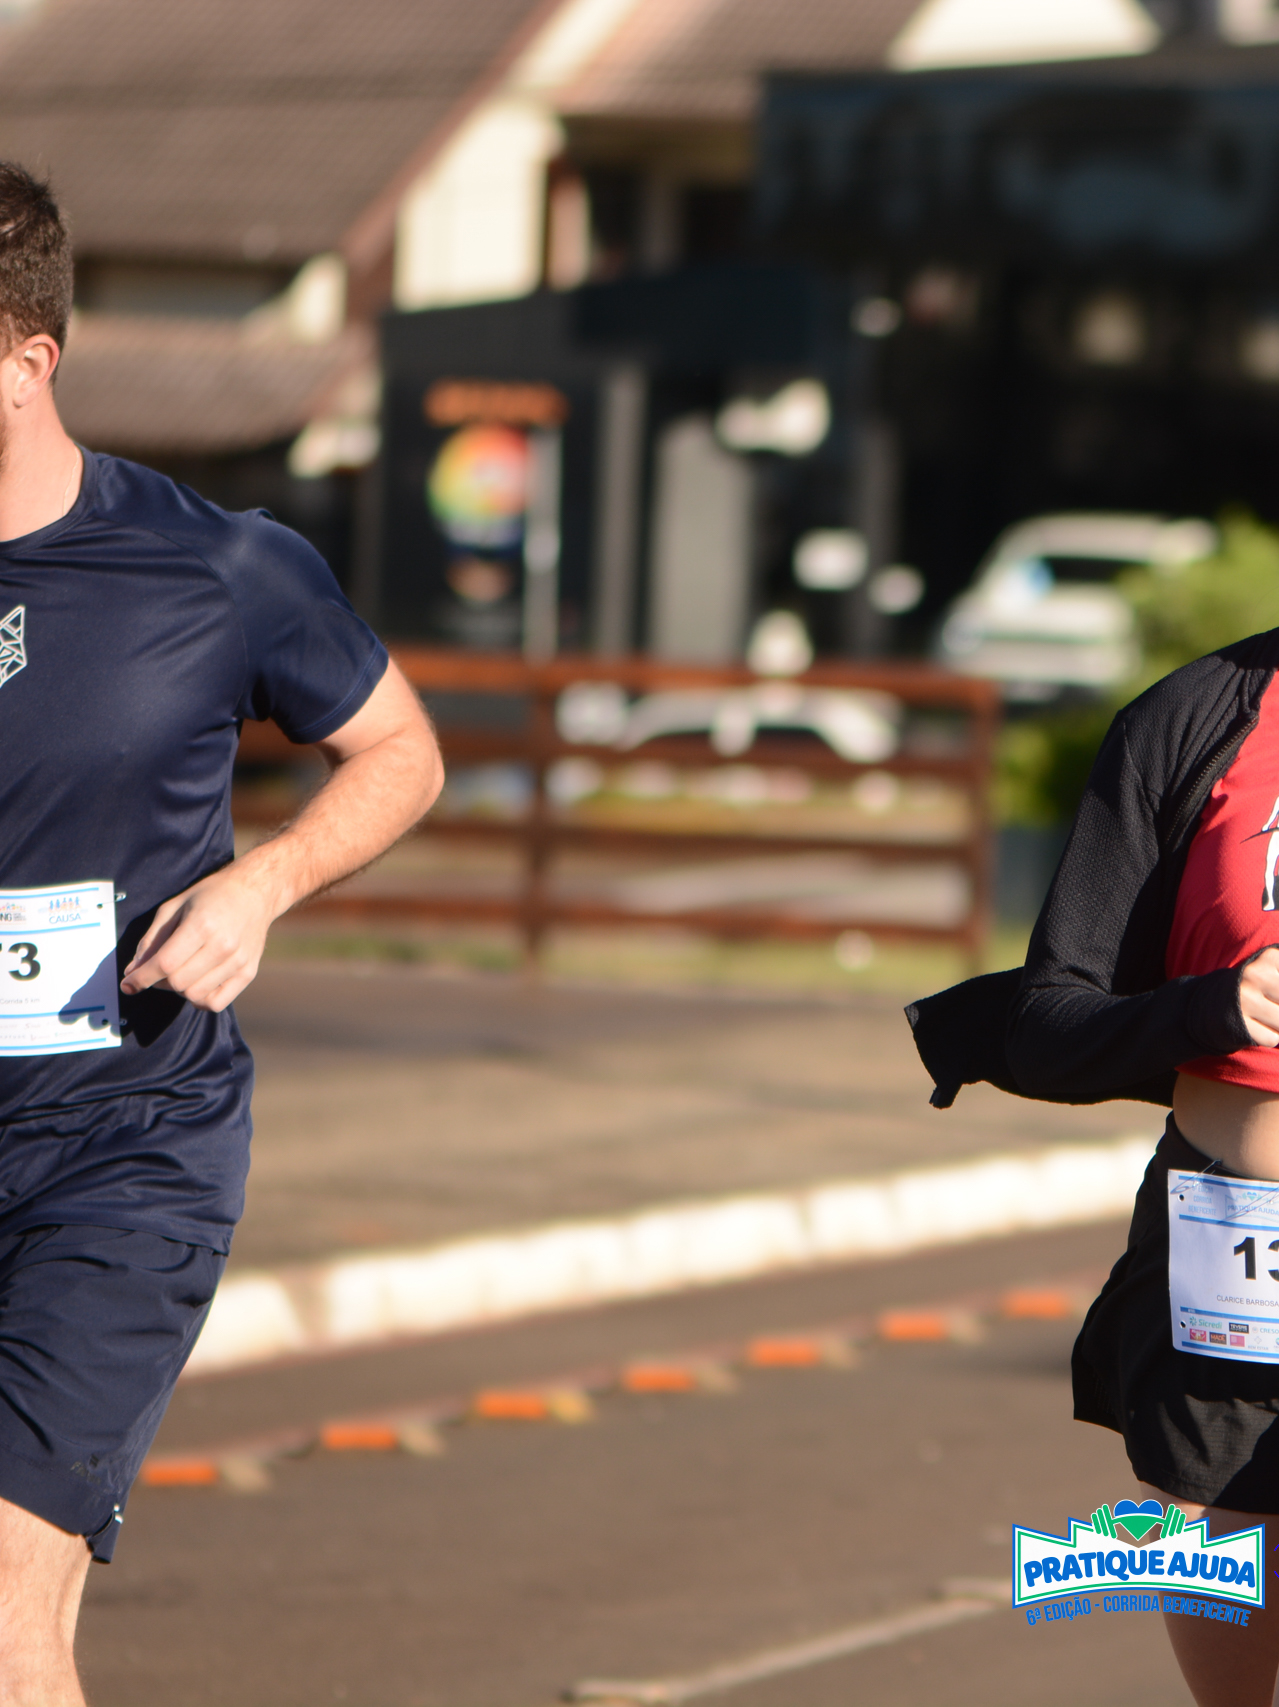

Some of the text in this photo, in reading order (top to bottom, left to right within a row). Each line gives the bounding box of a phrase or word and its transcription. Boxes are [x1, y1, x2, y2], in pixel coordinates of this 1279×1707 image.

[49, 912, 82, 924] CAUSA
[0, 942, 41, 982] 3
[1259, 1206, 1279, 1216] AJUDA
[1216, 1294, 1245, 1305] CLARICE
[1246, 1298, 1279, 1308] BARBOSA
[1198, 1318, 1223, 1329] Sicredi
